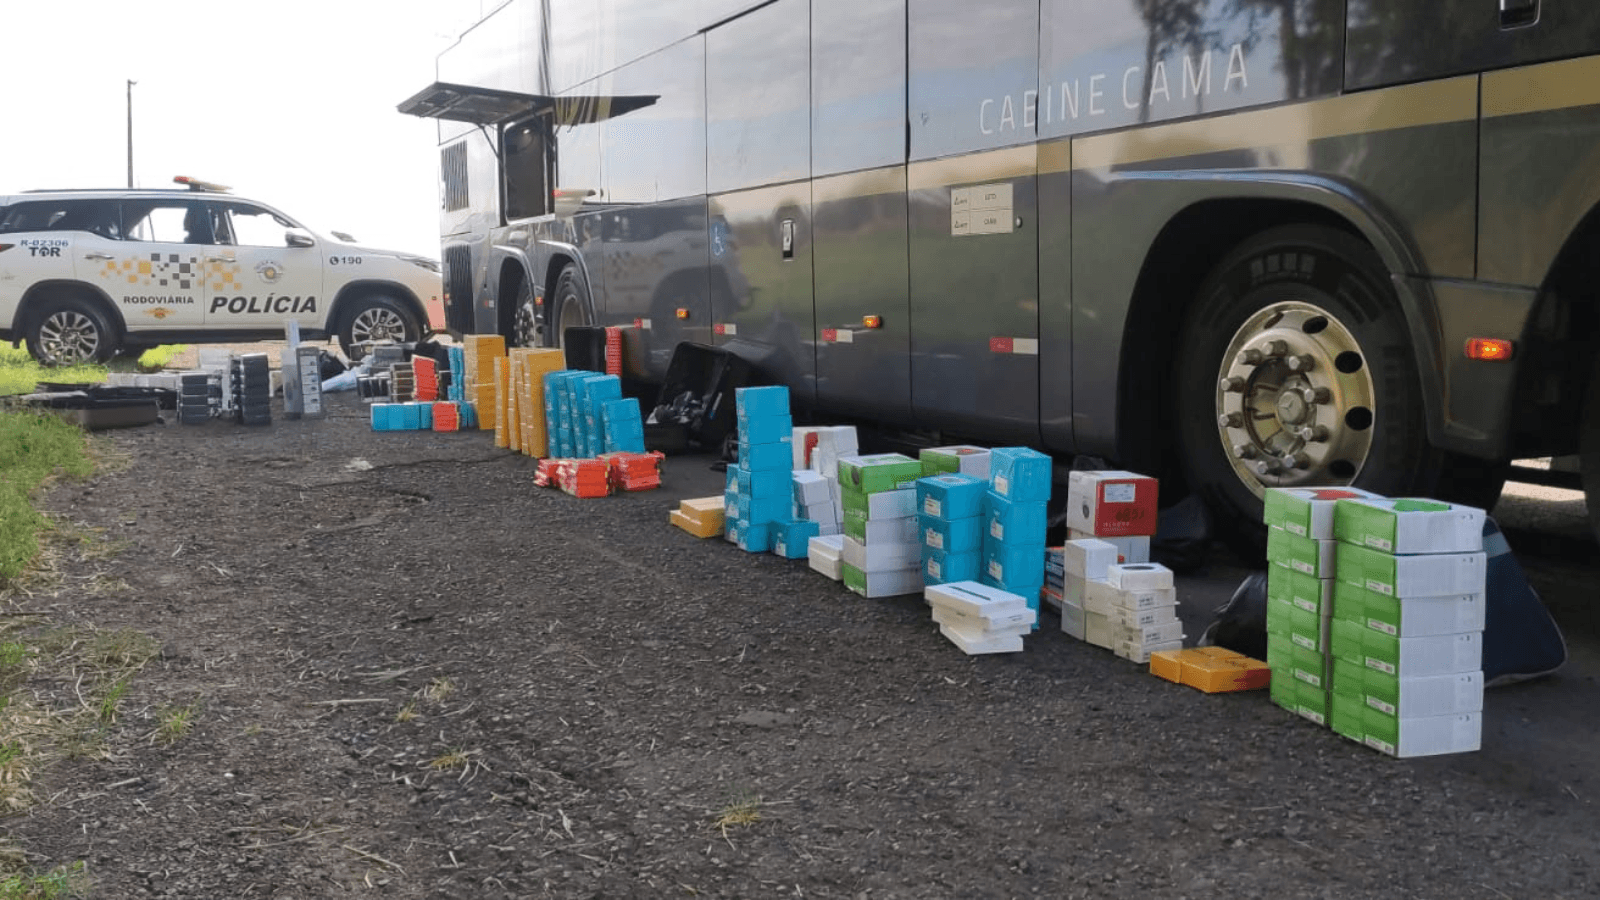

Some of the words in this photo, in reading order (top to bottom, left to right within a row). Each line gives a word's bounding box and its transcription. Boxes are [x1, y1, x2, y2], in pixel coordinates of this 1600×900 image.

[979, 73, 1106, 135] CABINE
[1122, 43, 1248, 109] CAMA
[28, 246, 61, 257] TOR
[340, 256, 362, 265] 190
[123, 294, 194, 304] RODOVIÁRIA
[209, 292, 317, 314] POLÍCIA
